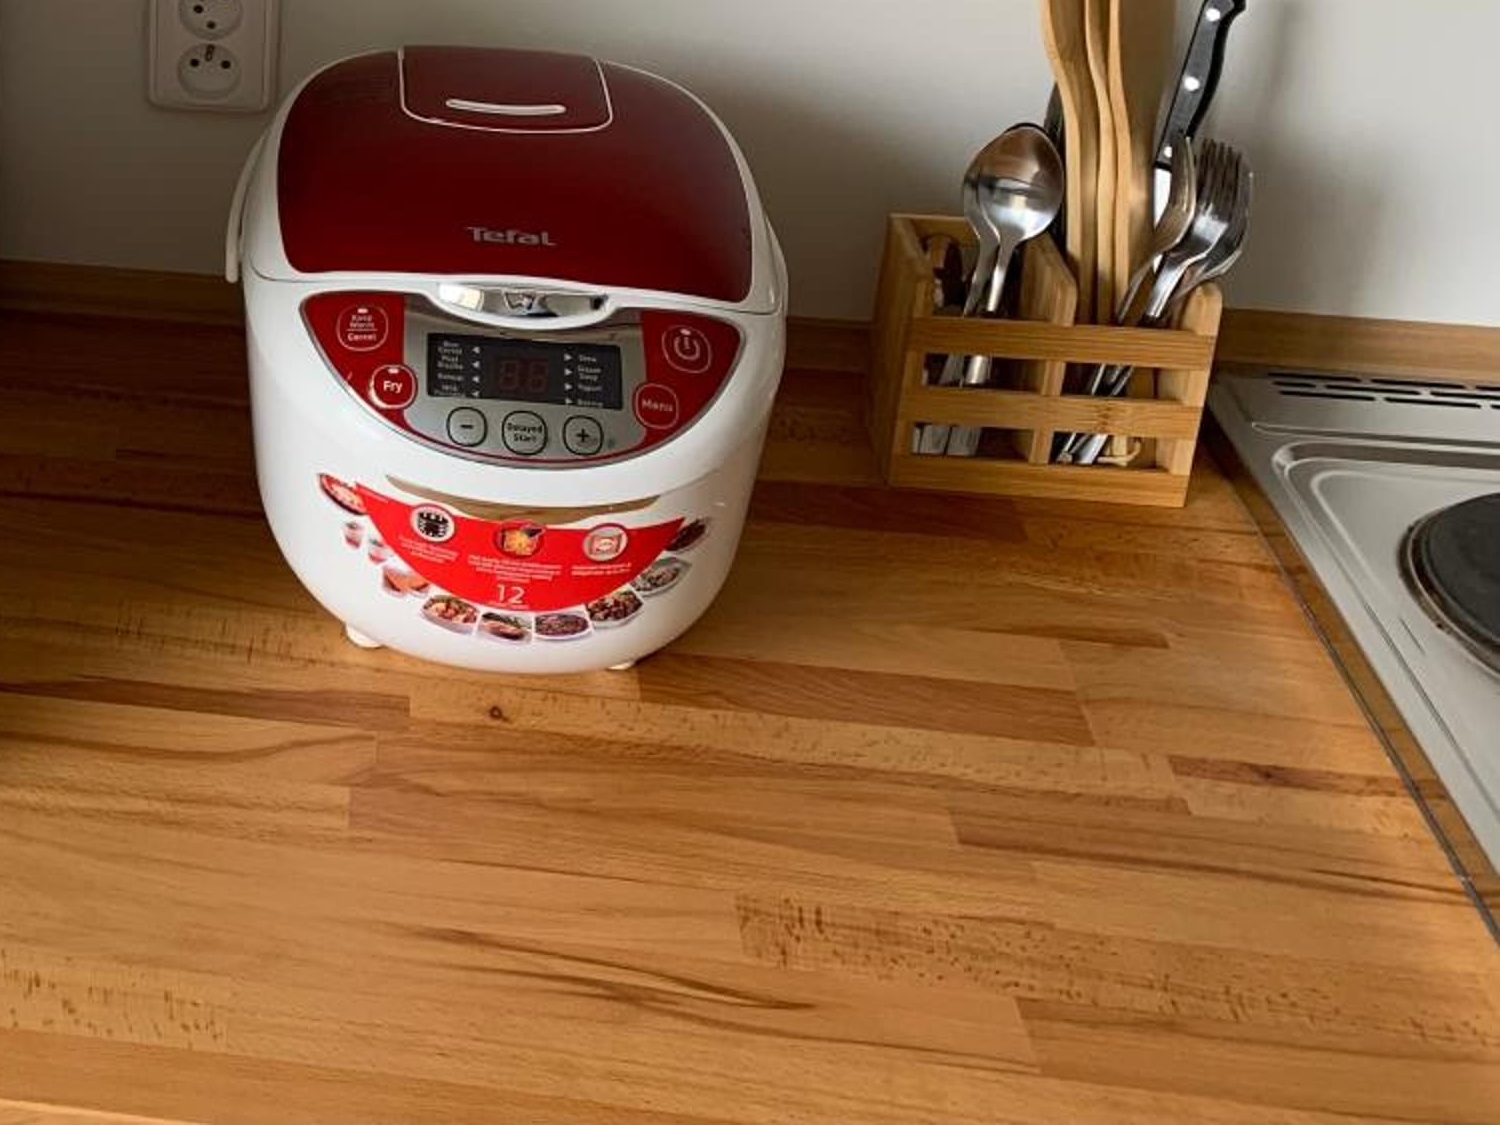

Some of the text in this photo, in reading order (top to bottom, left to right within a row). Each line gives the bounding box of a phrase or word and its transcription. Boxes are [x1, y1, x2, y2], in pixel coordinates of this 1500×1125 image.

[466, 226, 558, 246] Tefal
[382, 379, 403, 395] Fry
[641, 400, 674, 413] Menu
[496, 583, 526, 605] 12
